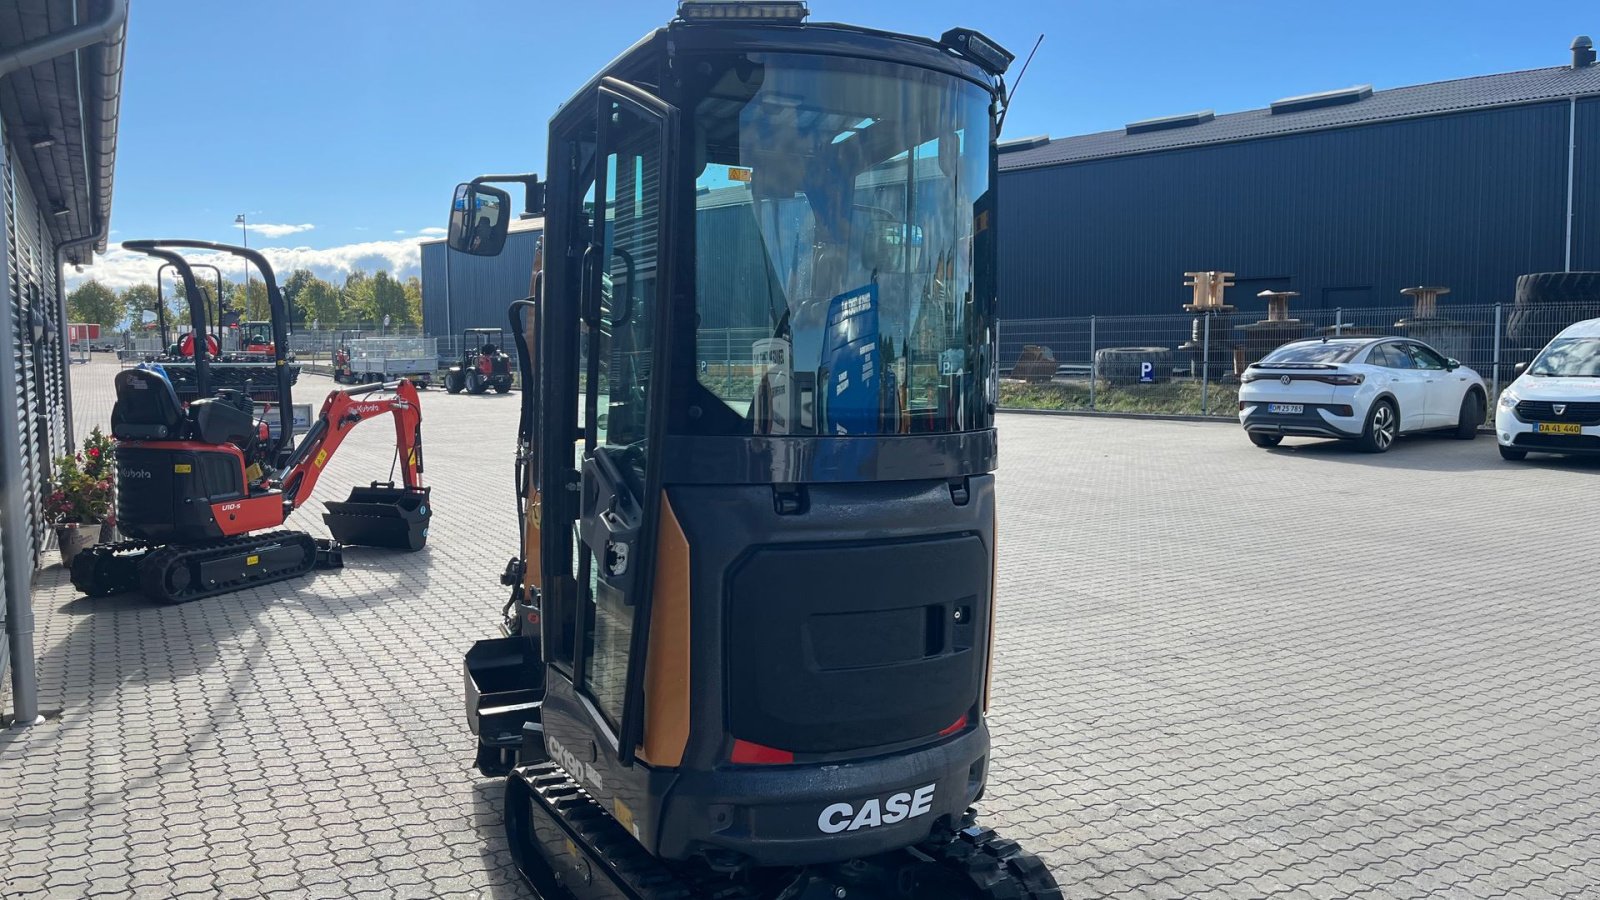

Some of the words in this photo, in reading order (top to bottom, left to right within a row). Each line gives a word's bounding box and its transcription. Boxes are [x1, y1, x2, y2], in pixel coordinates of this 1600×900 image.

[1141, 362, 1152, 377] P
[357, 404, 379, 413] Kubota
[120, 468, 151, 478] Kubota
[817, 783, 936, 834] CASE
